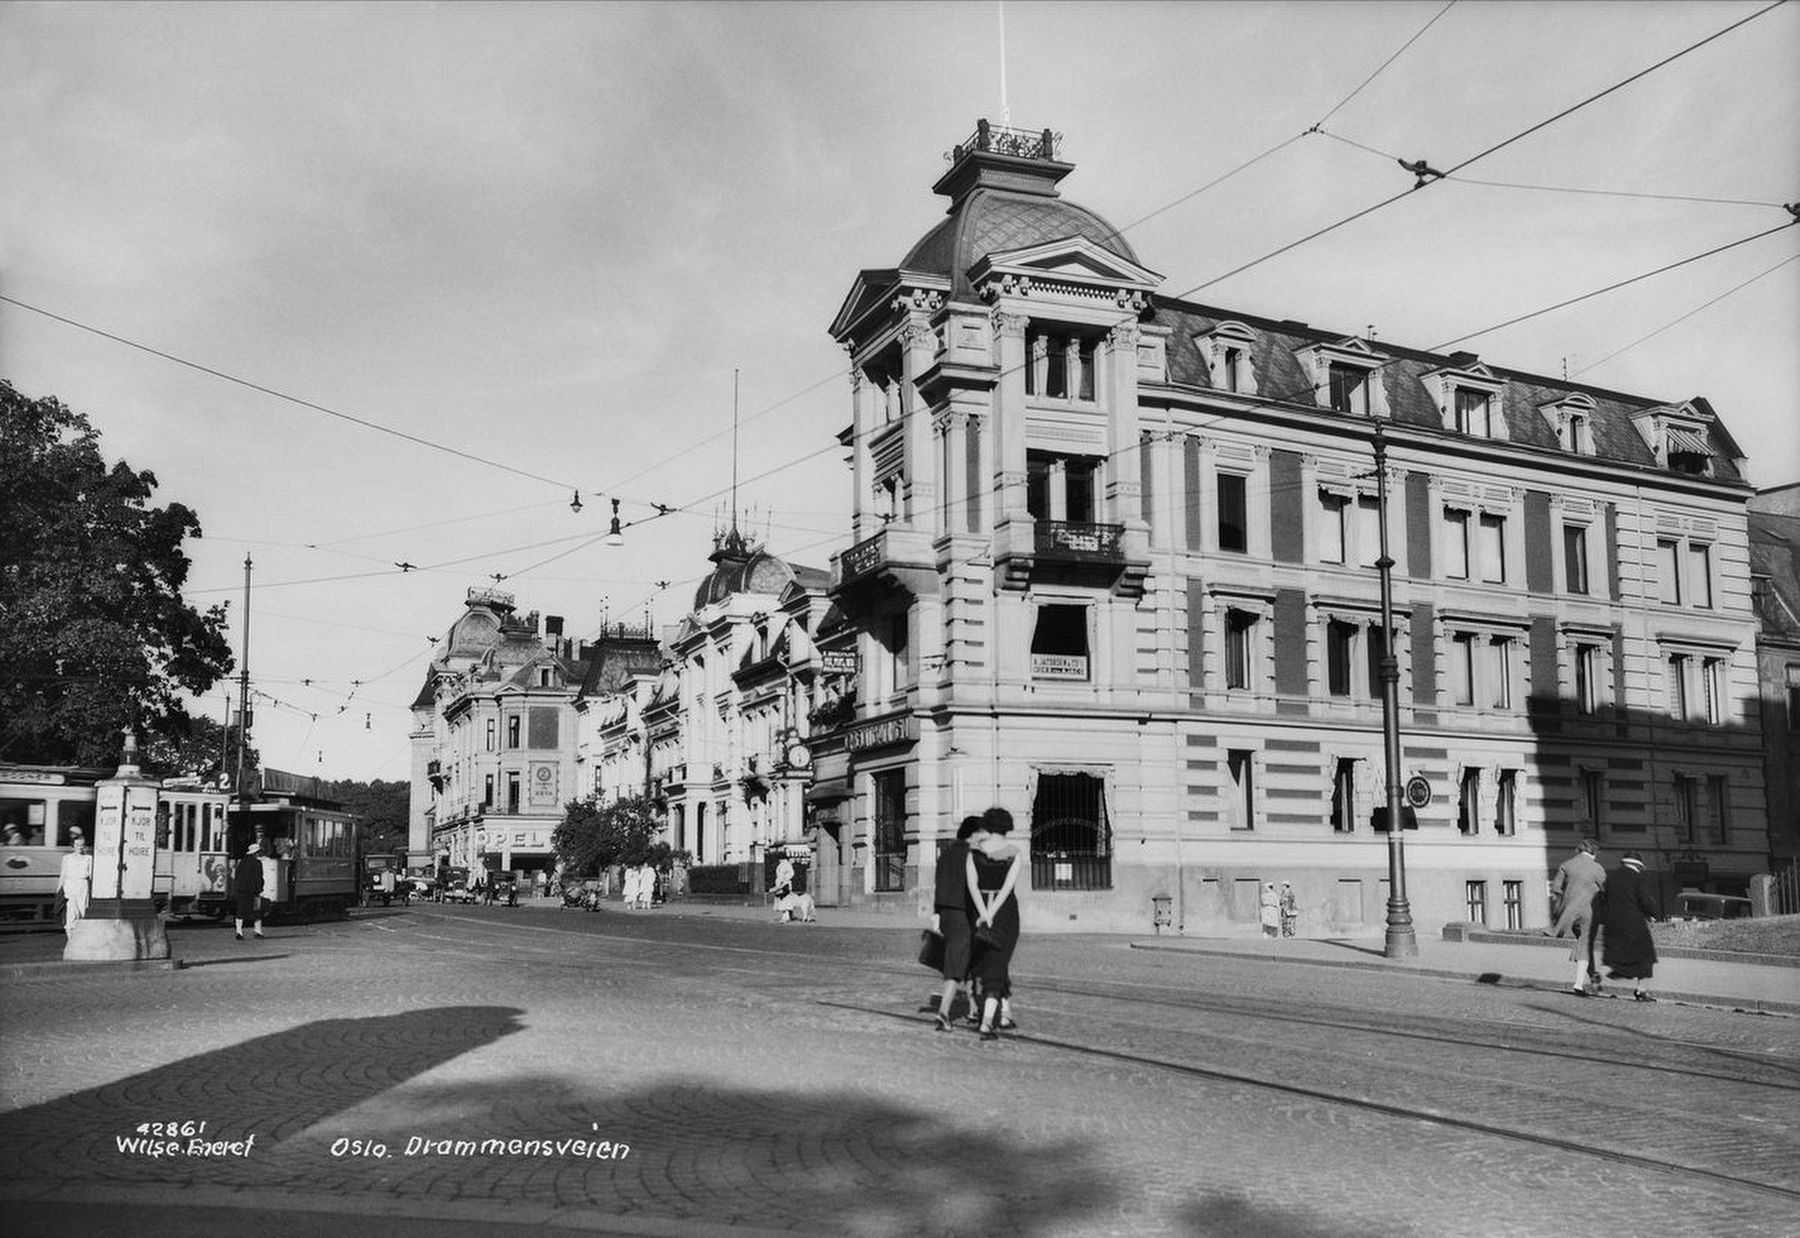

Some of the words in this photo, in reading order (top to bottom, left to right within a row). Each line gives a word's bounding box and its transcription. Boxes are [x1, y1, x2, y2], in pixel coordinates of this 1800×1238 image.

[219, 772, 231, 789] 2
[135, 831, 146, 842] TIL
[478, 830, 545, 848] OPEL
